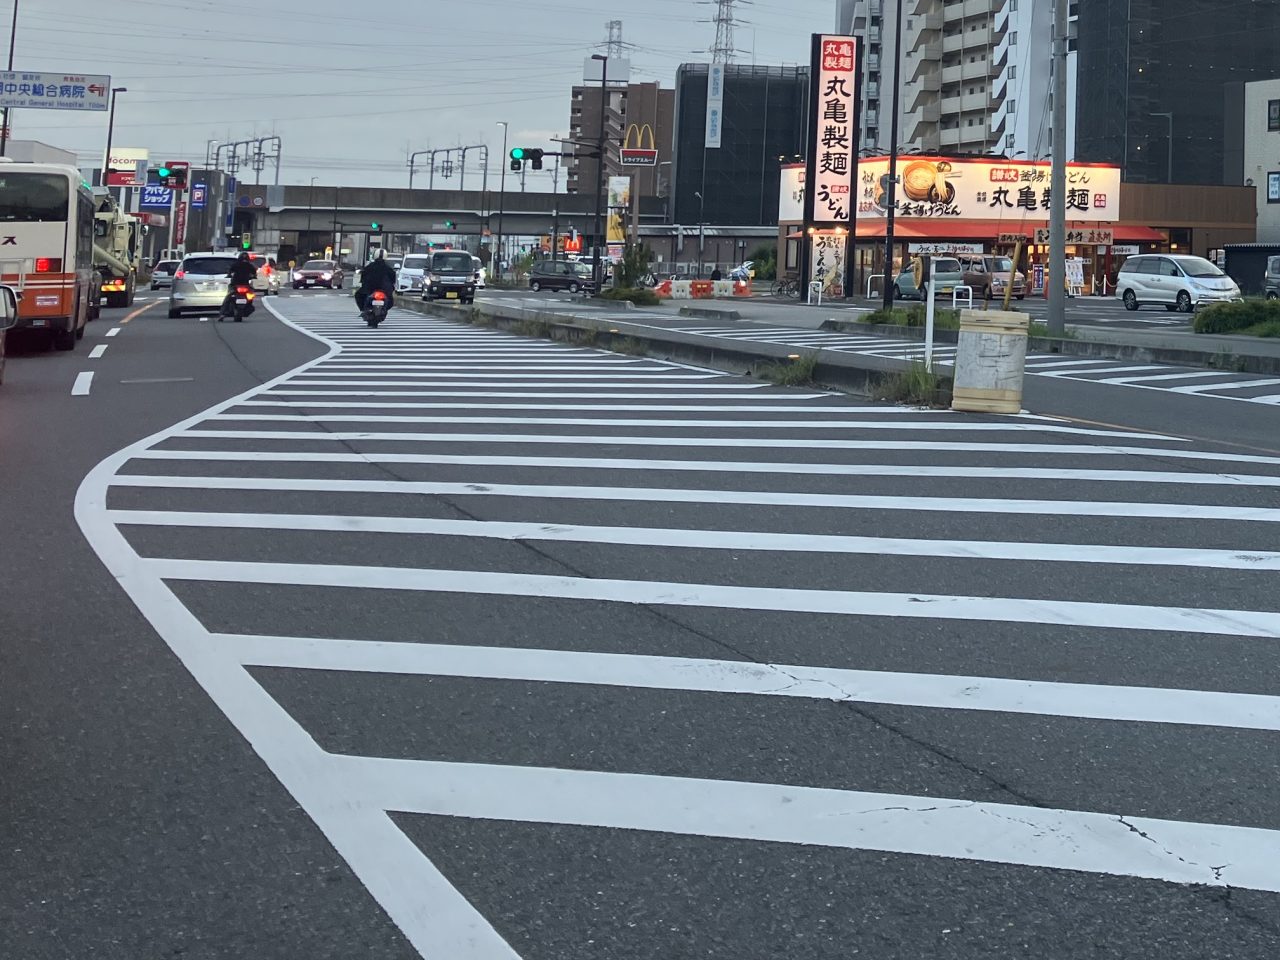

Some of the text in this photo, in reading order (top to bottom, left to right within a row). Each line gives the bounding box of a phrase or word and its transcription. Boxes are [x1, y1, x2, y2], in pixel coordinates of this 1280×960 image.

[29, 100, 55, 108] General
[820, 76, 852, 176] 丸亀製麺
[144, 195, 170, 203] ショップ
[818, 185, 848, 219] うどん
[901, 202, 961, 216] 釜揚げうどん
